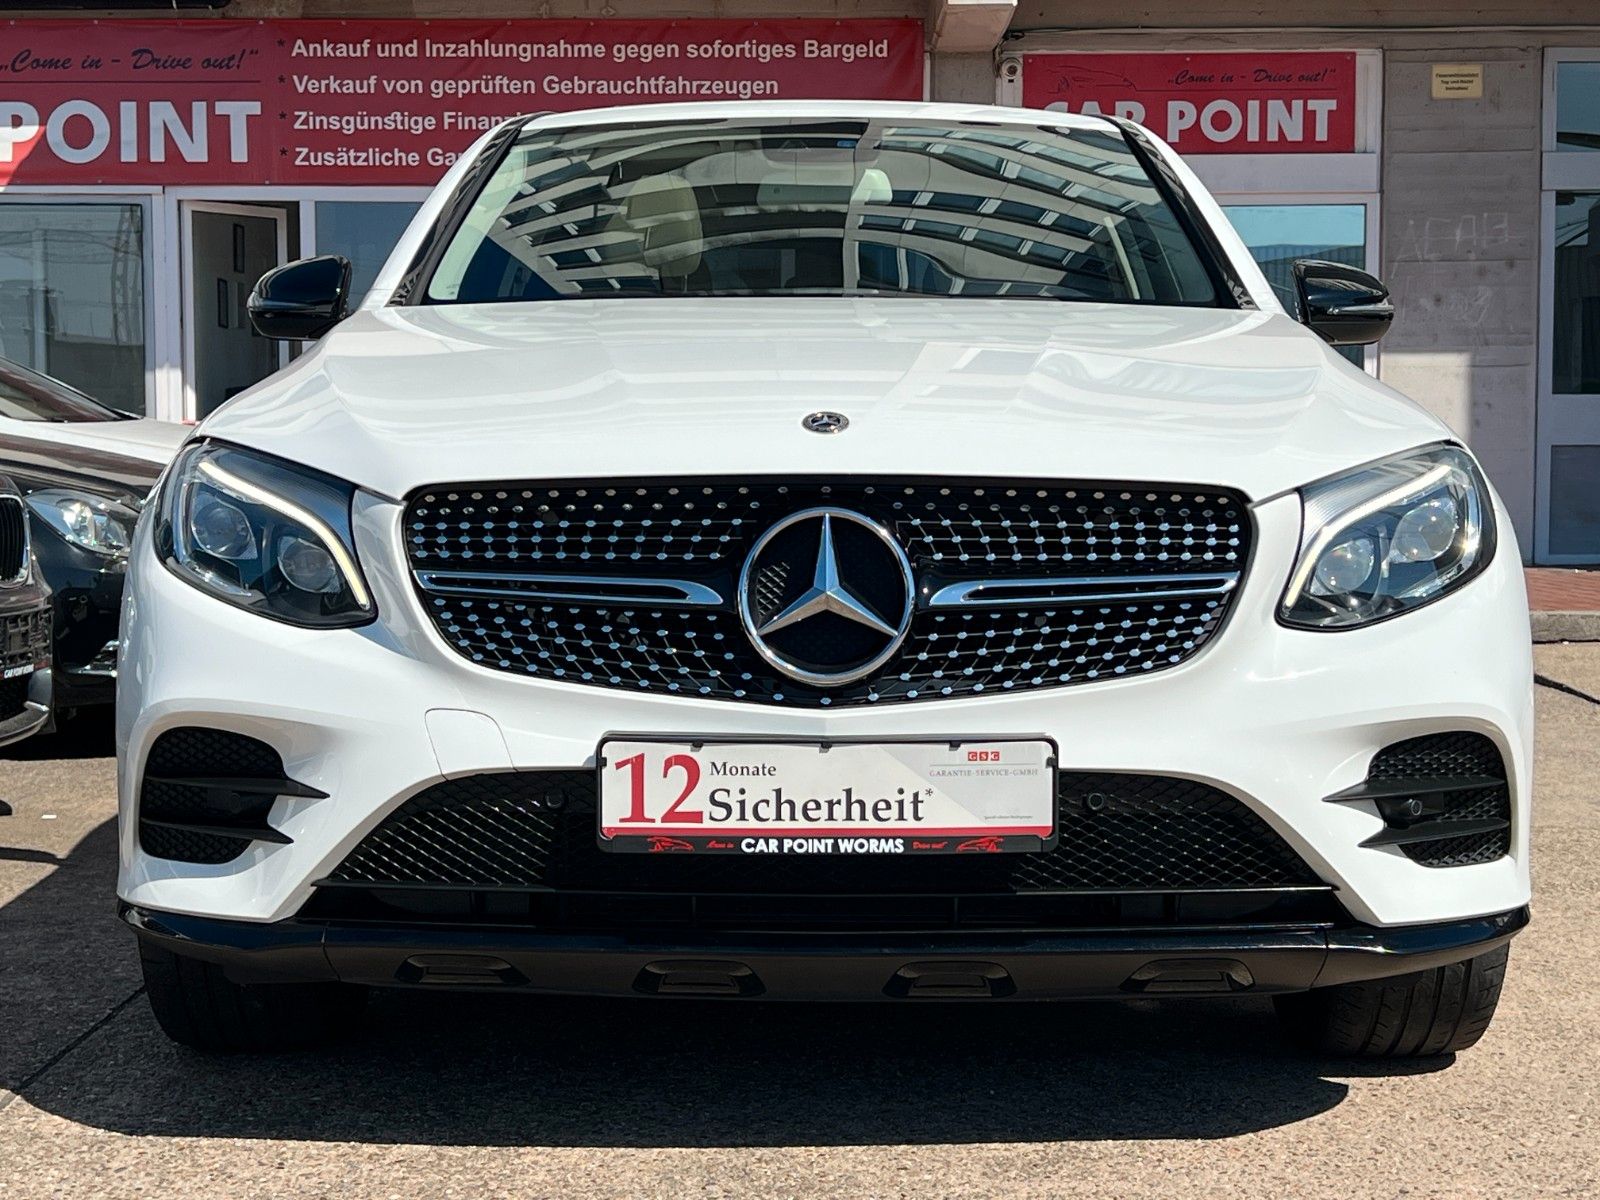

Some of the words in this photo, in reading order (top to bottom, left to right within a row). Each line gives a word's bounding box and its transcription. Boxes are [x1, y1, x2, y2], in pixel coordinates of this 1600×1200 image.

[81, 54, 103, 69] in
[131, 48, 192, 70] Drive
[291, 39, 371, 57] Ankauf
[377, 39, 418, 57] und
[425, 39, 606, 61] Inzahlungnahme
[612, 43, 680, 62] gegen
[686, 40, 797, 62] sofortiges
[804, 40, 888, 62] Bargeld
[292, 75, 378, 94] Verkauf
[383, 79, 423, 94] von
[430, 75, 536, 98] geprüften
[543, 75, 779, 98] Gebrauchtfahrzeugen
[1220, 71, 1234, 83] in
[1253, 69, 1294, 83] Drive
[0, 100, 262, 164] POINT
[293, 111, 436, 134] Zinsgünstige
[1167, 99, 1337, 143] POINT
[294, 147, 420, 166] Zusätzliche
[427, 147, 466, 167] Ga
[968, 752, 1000, 761] GSG
[709, 761, 777, 777] Monate
[614, 752, 704, 824] 12
[740, 838, 782, 853] CAR
[783, 838, 834, 853] POINT
[837, 838, 905, 853] WORMS
